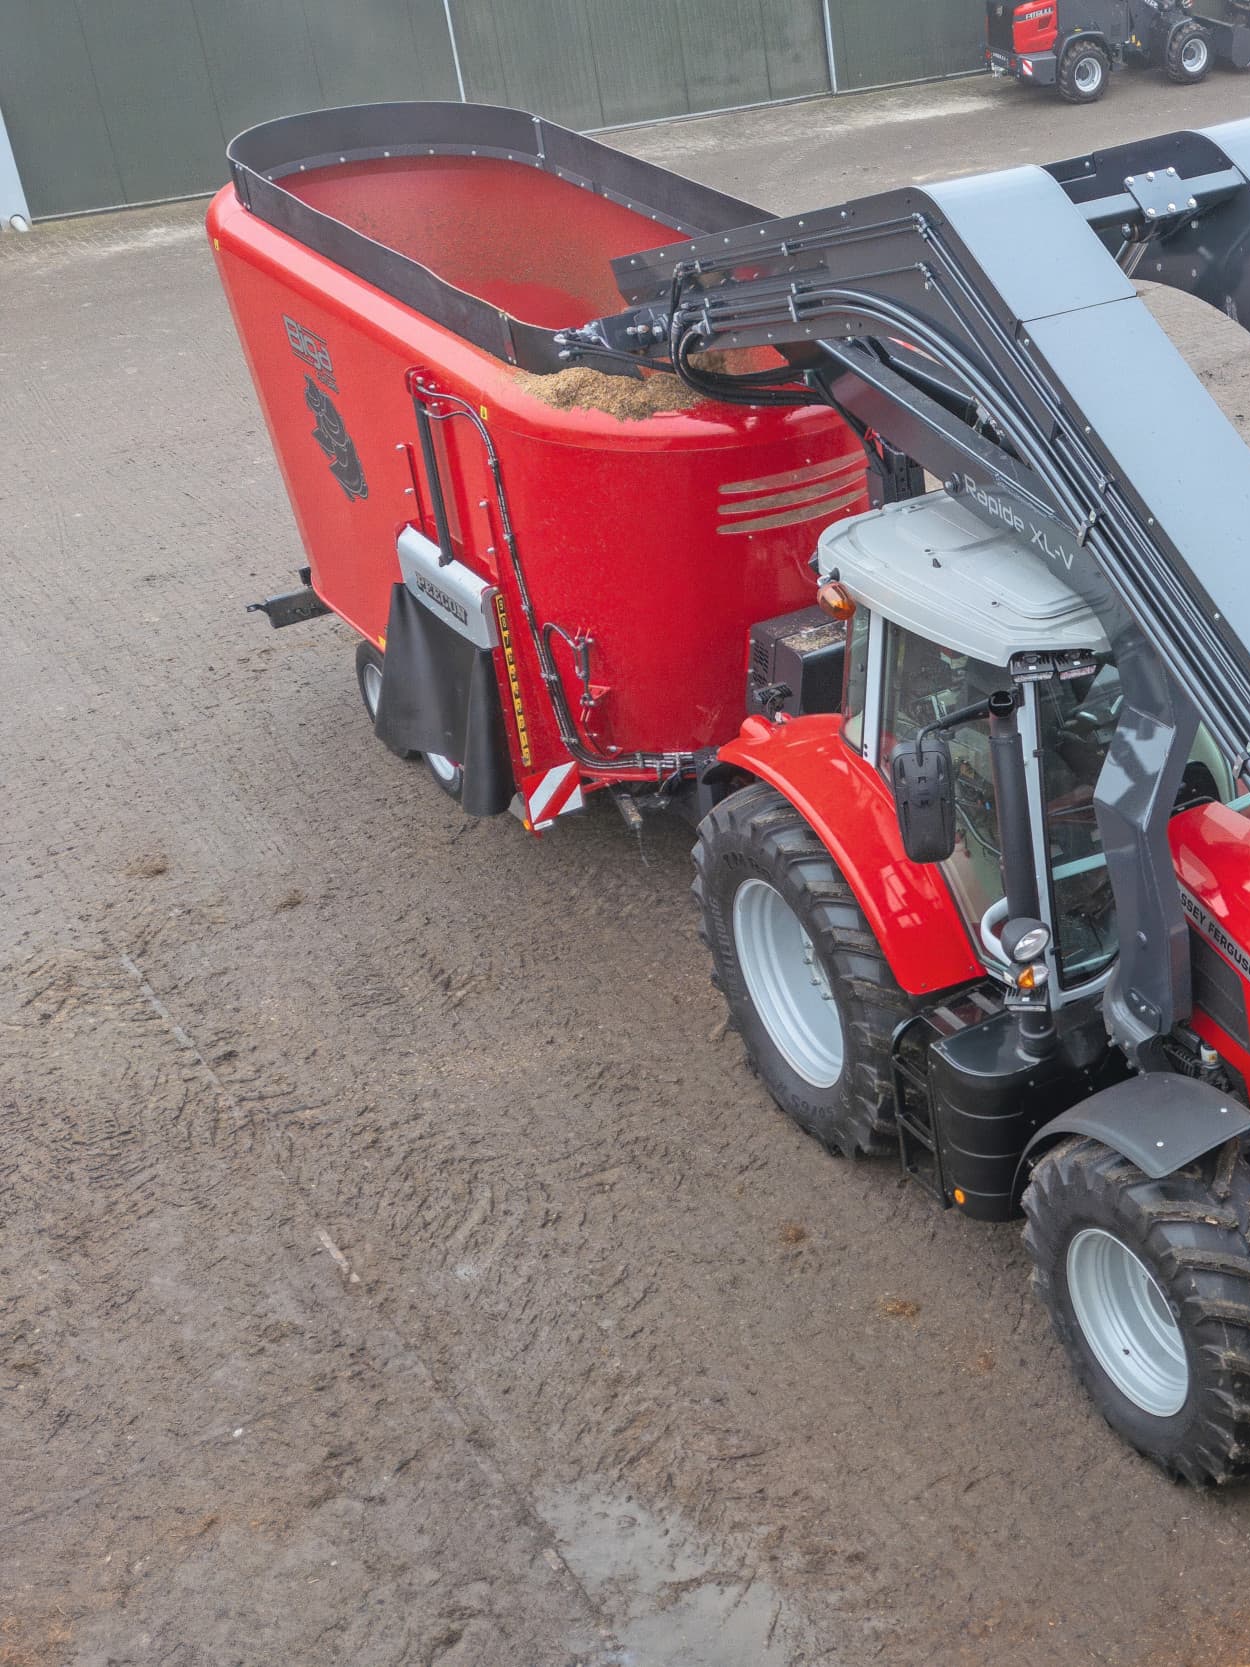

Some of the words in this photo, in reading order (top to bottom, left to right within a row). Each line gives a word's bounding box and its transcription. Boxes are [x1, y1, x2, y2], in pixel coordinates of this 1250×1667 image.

[964, 474, 1024, 533] Rapide
[1029, 522, 1073, 570] XL-V
[415, 572, 468, 625] PEECON
[1180, 893, 1206, 926] SSEY
